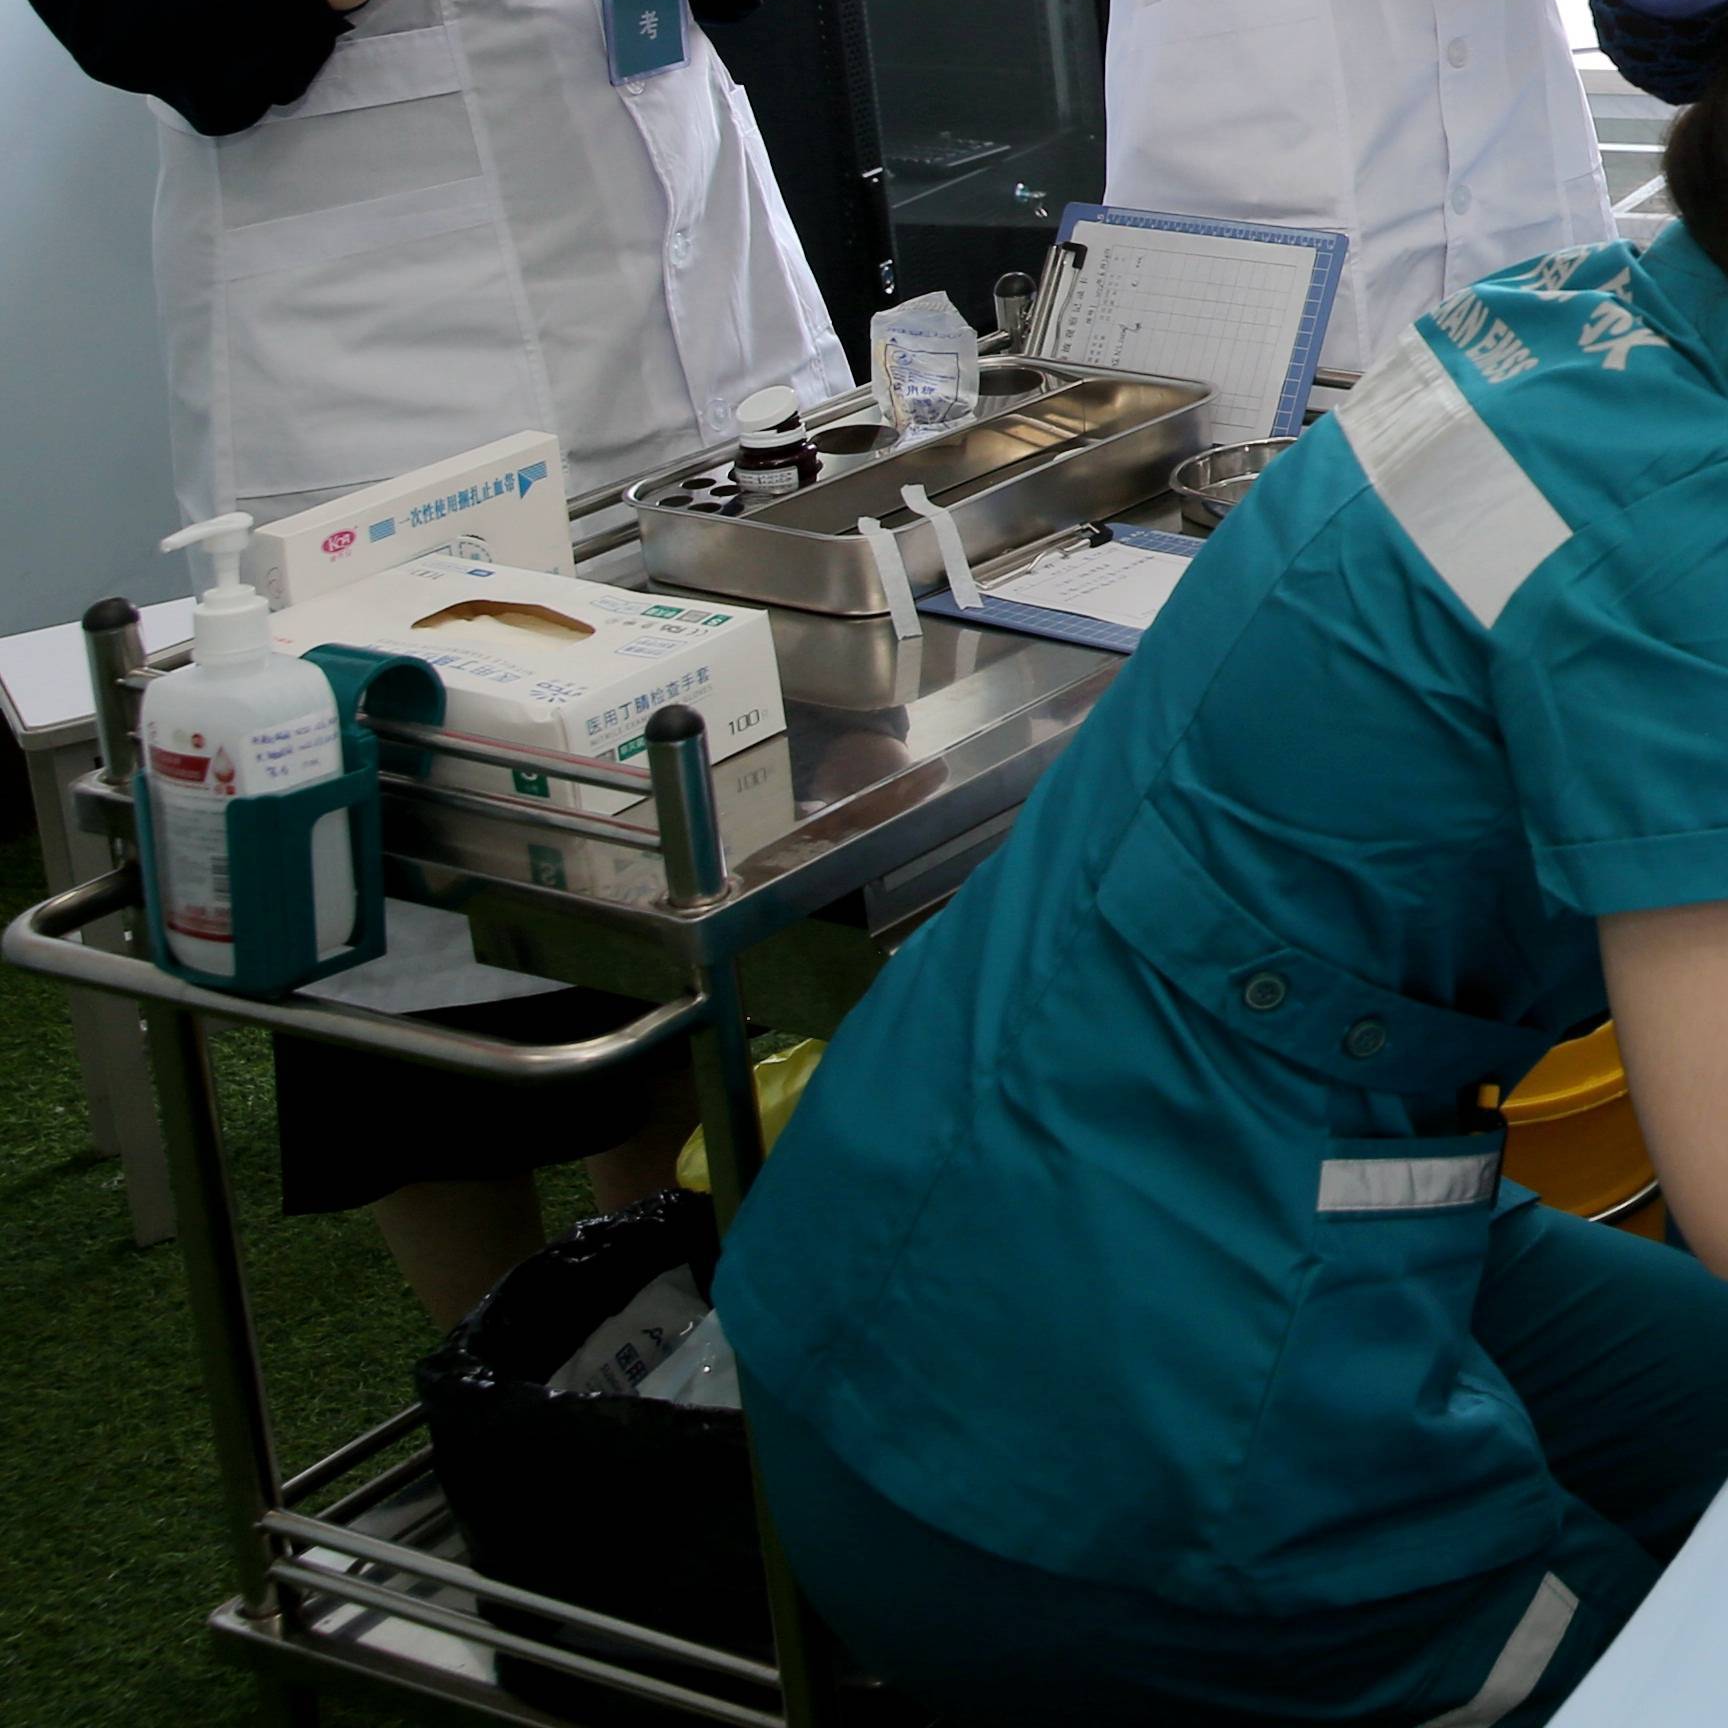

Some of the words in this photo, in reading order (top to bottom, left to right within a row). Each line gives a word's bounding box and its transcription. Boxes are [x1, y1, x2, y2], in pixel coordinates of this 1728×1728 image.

[585, 665, 712, 736] 医用丁腈检查手套
